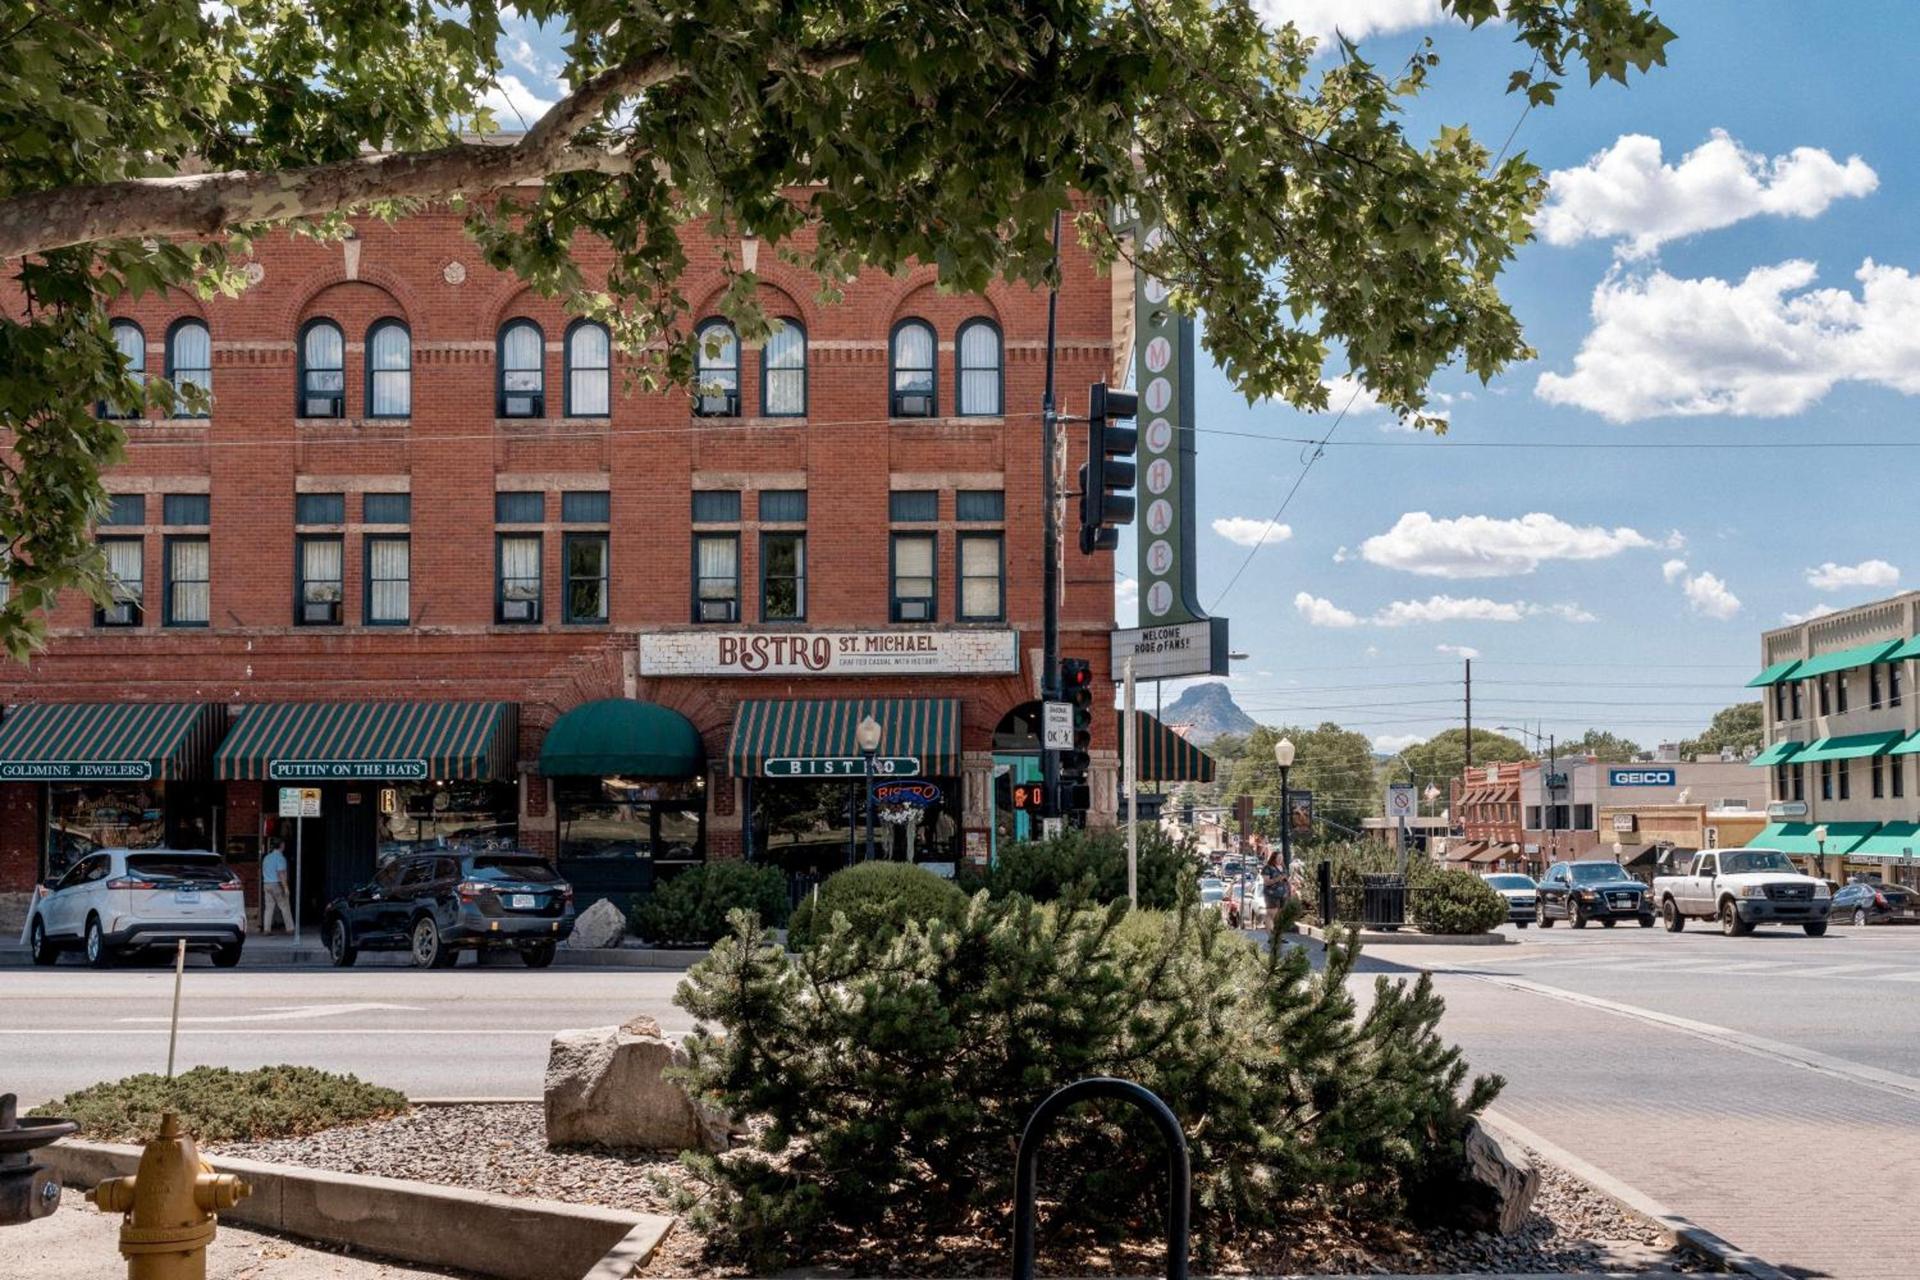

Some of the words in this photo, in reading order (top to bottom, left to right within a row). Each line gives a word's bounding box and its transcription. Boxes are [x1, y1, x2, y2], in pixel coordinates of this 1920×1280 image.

[1148, 340, 1170, 614] MICHAEL
[838, 636, 860, 652] ST.
[865, 635, 938, 652] MICHAEL
[718, 635, 831, 672] BISTRO
[1047, 730, 1058, 743] OK
[2, 765, 71, 776] GOLDMINE
[77, 765, 144, 776] JEWELERS
[277, 764, 329, 776] PUTTIN'
[332, 764, 351, 775] ON
[354, 764, 382, 775] THE
[386, 764, 420, 775] HATS
[790, 760, 896, 775] BISTO
[1615, 772, 1671, 784] GEICO
[1708, 828, 1716, 849] PU
